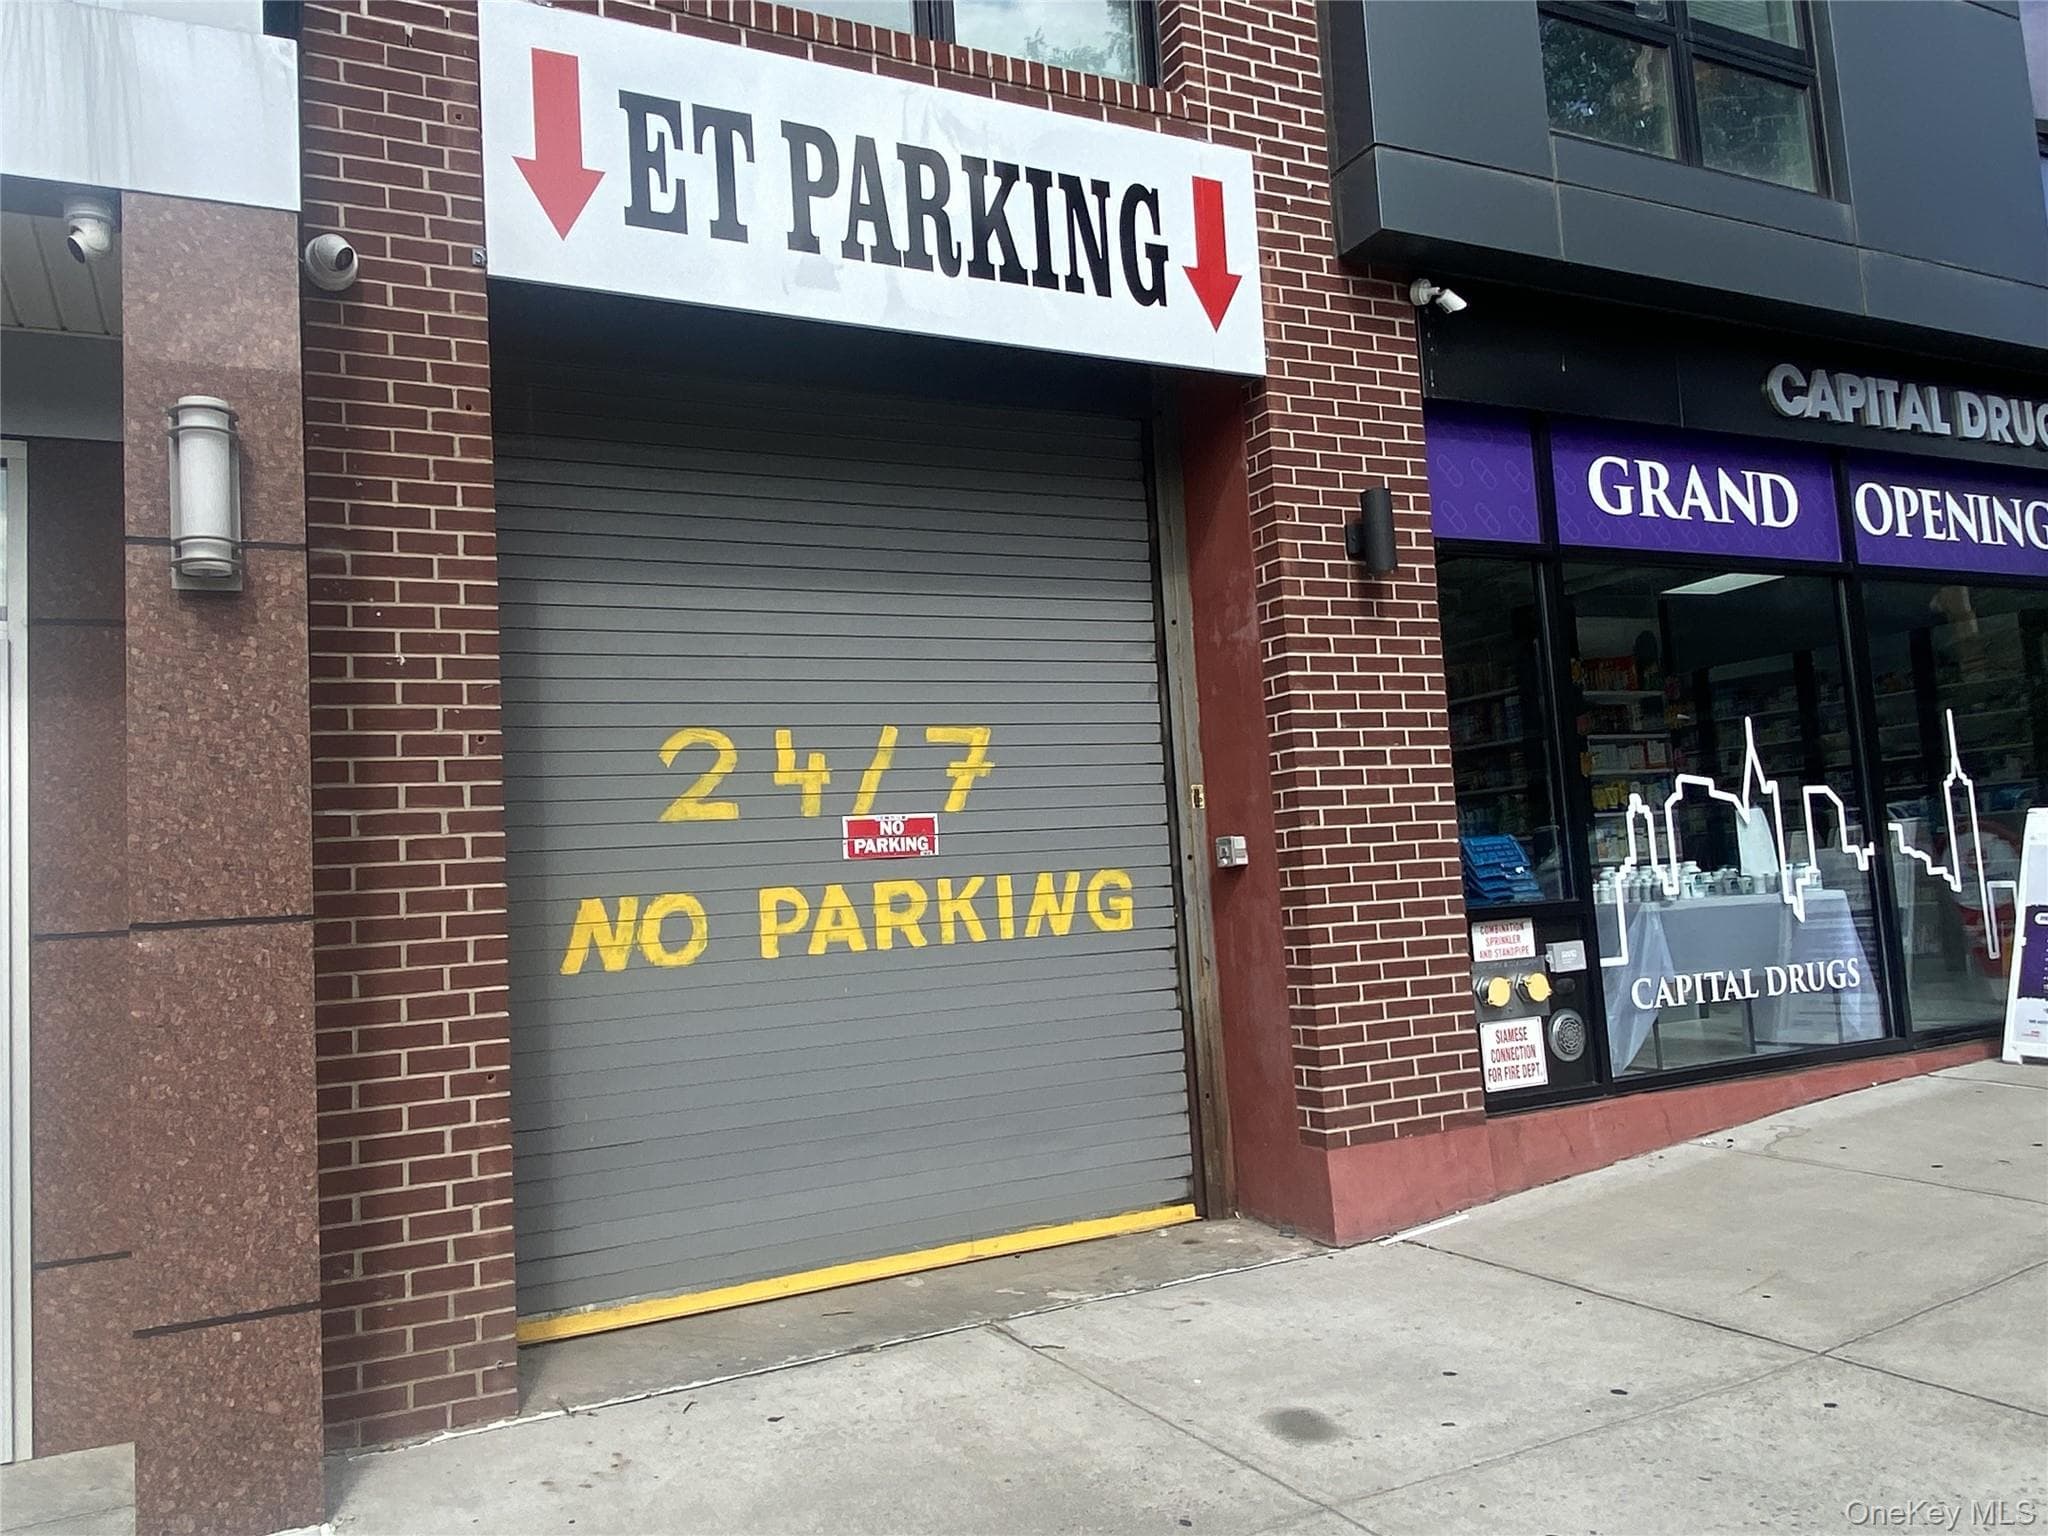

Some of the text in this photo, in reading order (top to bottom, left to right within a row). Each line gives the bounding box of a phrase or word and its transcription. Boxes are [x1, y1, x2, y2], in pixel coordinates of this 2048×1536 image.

[617, 88, 1170, 308] ET PARKING
[1764, 363, 1952, 436] CAPITAL
[1587, 455, 1800, 529] GRAND
[880, 819, 905, 836] NO
[853, 836, 929, 854] PARKING
[560, 868, 1134, 976] NO PARKING
[1480, 922, 1525, 935] COMBINATION
[1486, 934, 1521, 947] SPRINKLER
[1480, 945, 1530, 959] AND STANDPIPE
[1631, 957, 1861, 1010] CAPITAL DRUGS
[1495, 1026, 1528, 1045] SIAMESE
[1490, 1044, 1536, 1064] CONNECTION
[1488, 1067, 1503, 1083] FOR
[1504, 1064, 1521, 1080] FIRE
